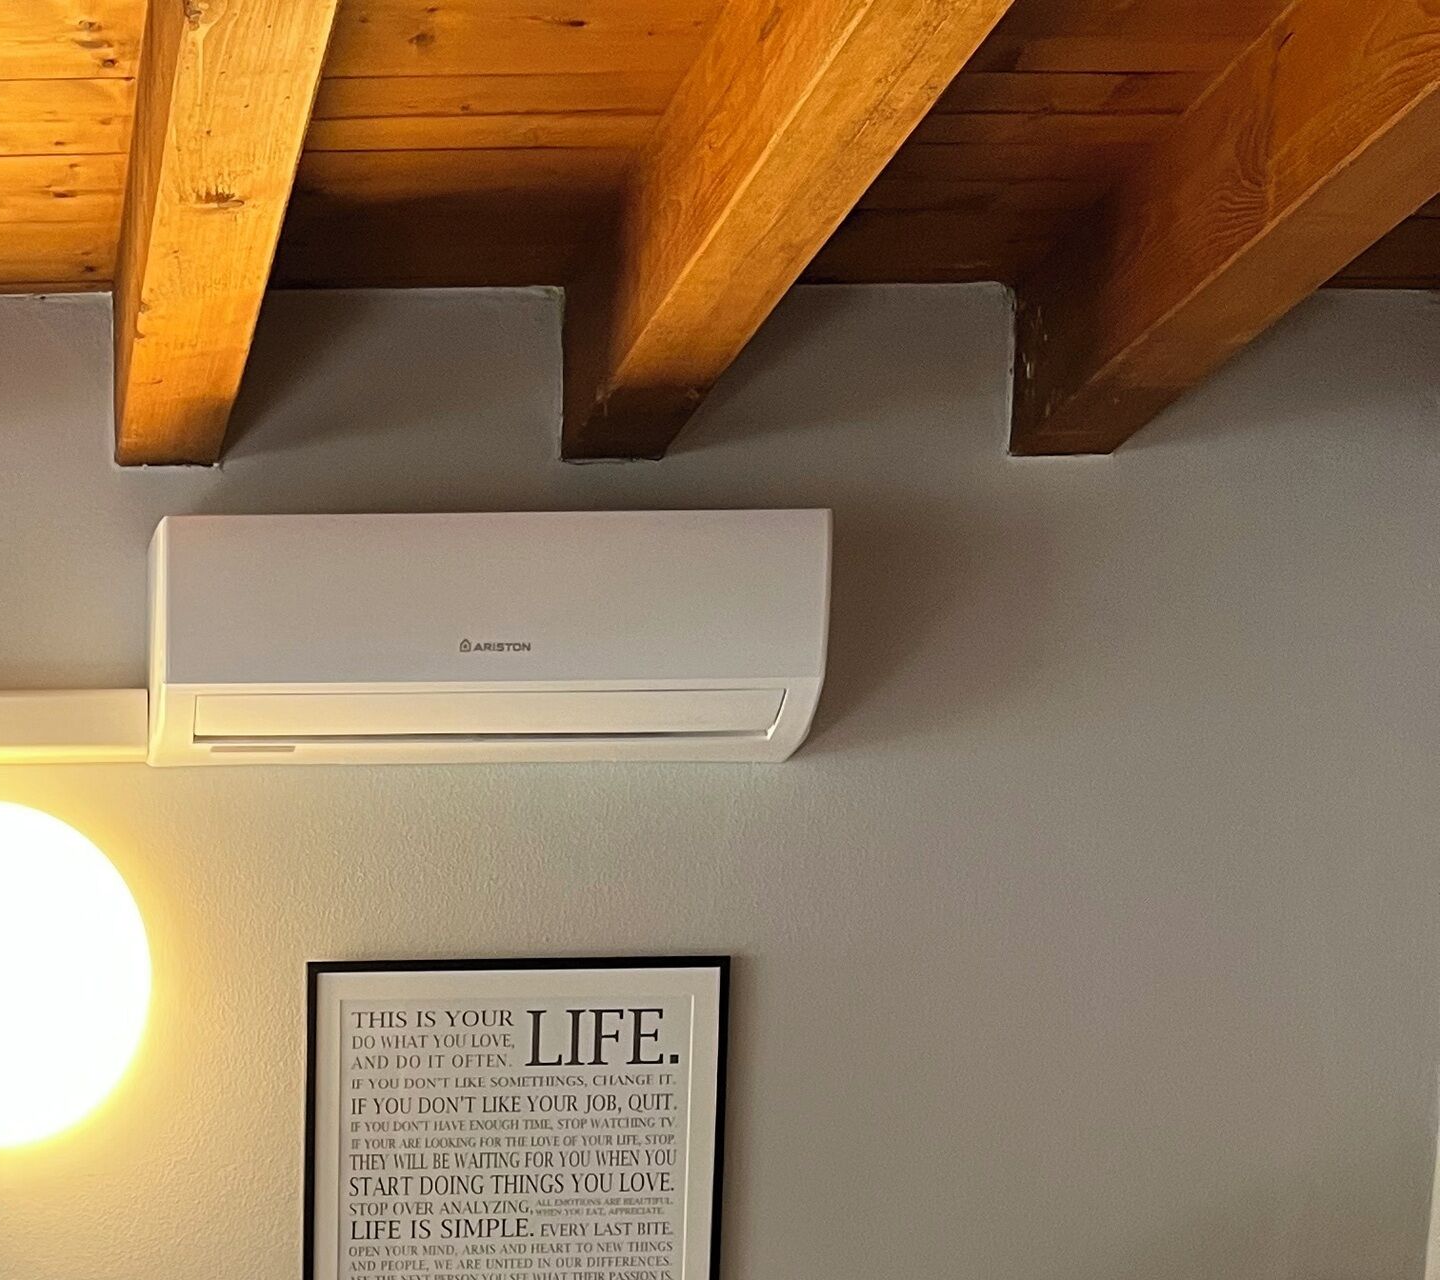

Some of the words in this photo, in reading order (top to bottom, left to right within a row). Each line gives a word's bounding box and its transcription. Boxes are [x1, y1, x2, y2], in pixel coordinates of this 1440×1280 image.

[473, 642, 532, 652] ARISTON
[350, 1011, 408, 1029] THIS
[415, 1010, 437, 1028] IS
[444, 1010, 515, 1028] YOUR
[351, 1035, 376, 1051] DO
[380, 1034, 429, 1050] WHAT
[433, 1034, 466, 1050] YOU
[470, 1033, 516, 1049] LOVE,
[524, 1008, 680, 1067] LIFE.
[350, 1054, 389, 1070] AND
[395, 1054, 422, 1070] DO
[427, 1054, 446, 1069] IT
[351, 1078, 365, 1090] IF
[368, 1077, 400, 1090] YOU
[403, 1077, 451, 1090] DON'T
[454, 1076, 486, 1089] LIKE
[592, 1074, 654, 1087] CHANGE
[350, 1098, 368, 1116] IF
[372, 1097, 412, 1115] YOU
[417, 1096, 477, 1115] DON'T
[481, 1095, 522, 1114] LIKE
[526, 1094, 578, 1113] YOUR
[583, 1094, 623, 1112] JOB,
[627, 1093, 679, 1112] QUIT.
[349, 1153, 390, 1171] THEY
[393, 1153, 428, 1171] WILL
[432, 1152, 451, 1170] BE
[454, 1151, 521, 1170] WAITING
[524, 1151, 554, 1169] FOR
[557, 1150, 591, 1168] YOU
[595, 1149, 640, 1168] WHEN
[645, 1149, 677, 1167] YOU
[348, 1175, 414, 1198] START
[419, 1174, 484, 1197] DOING
[489, 1173, 565, 1195] THINGS
[570, 1173, 614, 1194] YOU
[618, 1172, 676, 1193] LOVE.
[348, 1202, 389, 1217] STOP
[392, 1201, 435, 1217] OVER
[350, 1219, 402, 1241] LIFE
[409, 1219, 432, 1240] IS
[439, 1218, 535, 1240] SIMPLE.
[540, 1222, 590, 1238] EVERY
[593, 1222, 633, 1237] LAST
[348, 1245, 381, 1257] OPEN
[384, 1245, 418, 1257] YOUR
[461, 1243, 497, 1256] ARMS
[501, 1243, 527, 1255] AND
[530, 1242, 572, 1254] HEART
[575, 1242, 593, 1254] TO
[626, 1241, 673, 1253] THINGS
